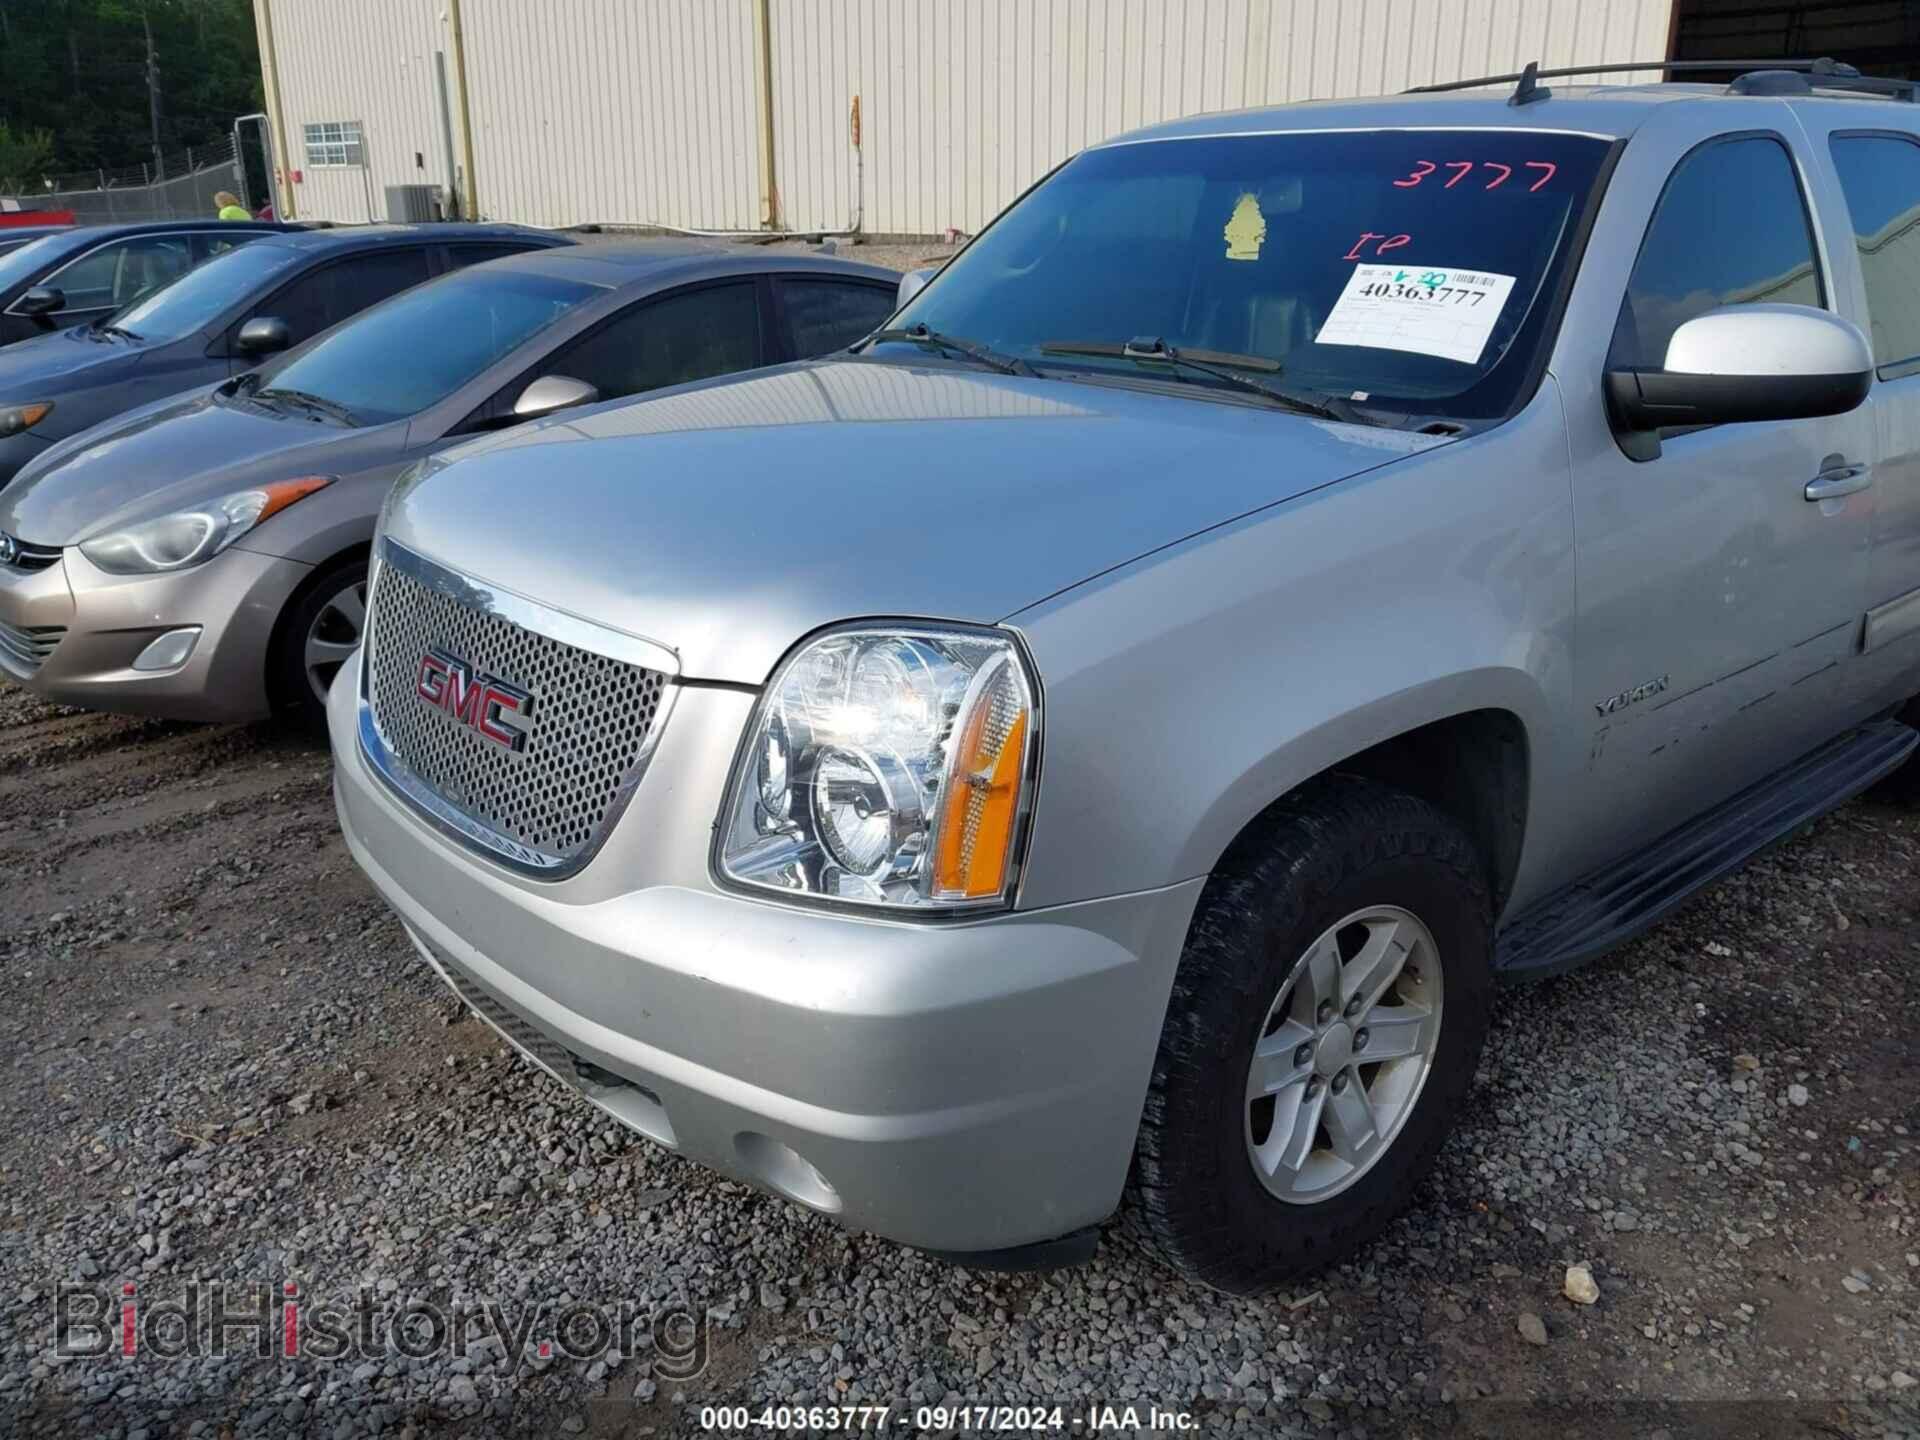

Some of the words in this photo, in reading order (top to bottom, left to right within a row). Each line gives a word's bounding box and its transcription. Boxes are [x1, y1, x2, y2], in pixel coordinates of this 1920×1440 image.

[1393, 160, 1557, 192] 3777
[1358, 282, 1487, 307] 40363777
[417, 648, 535, 753] GMC
